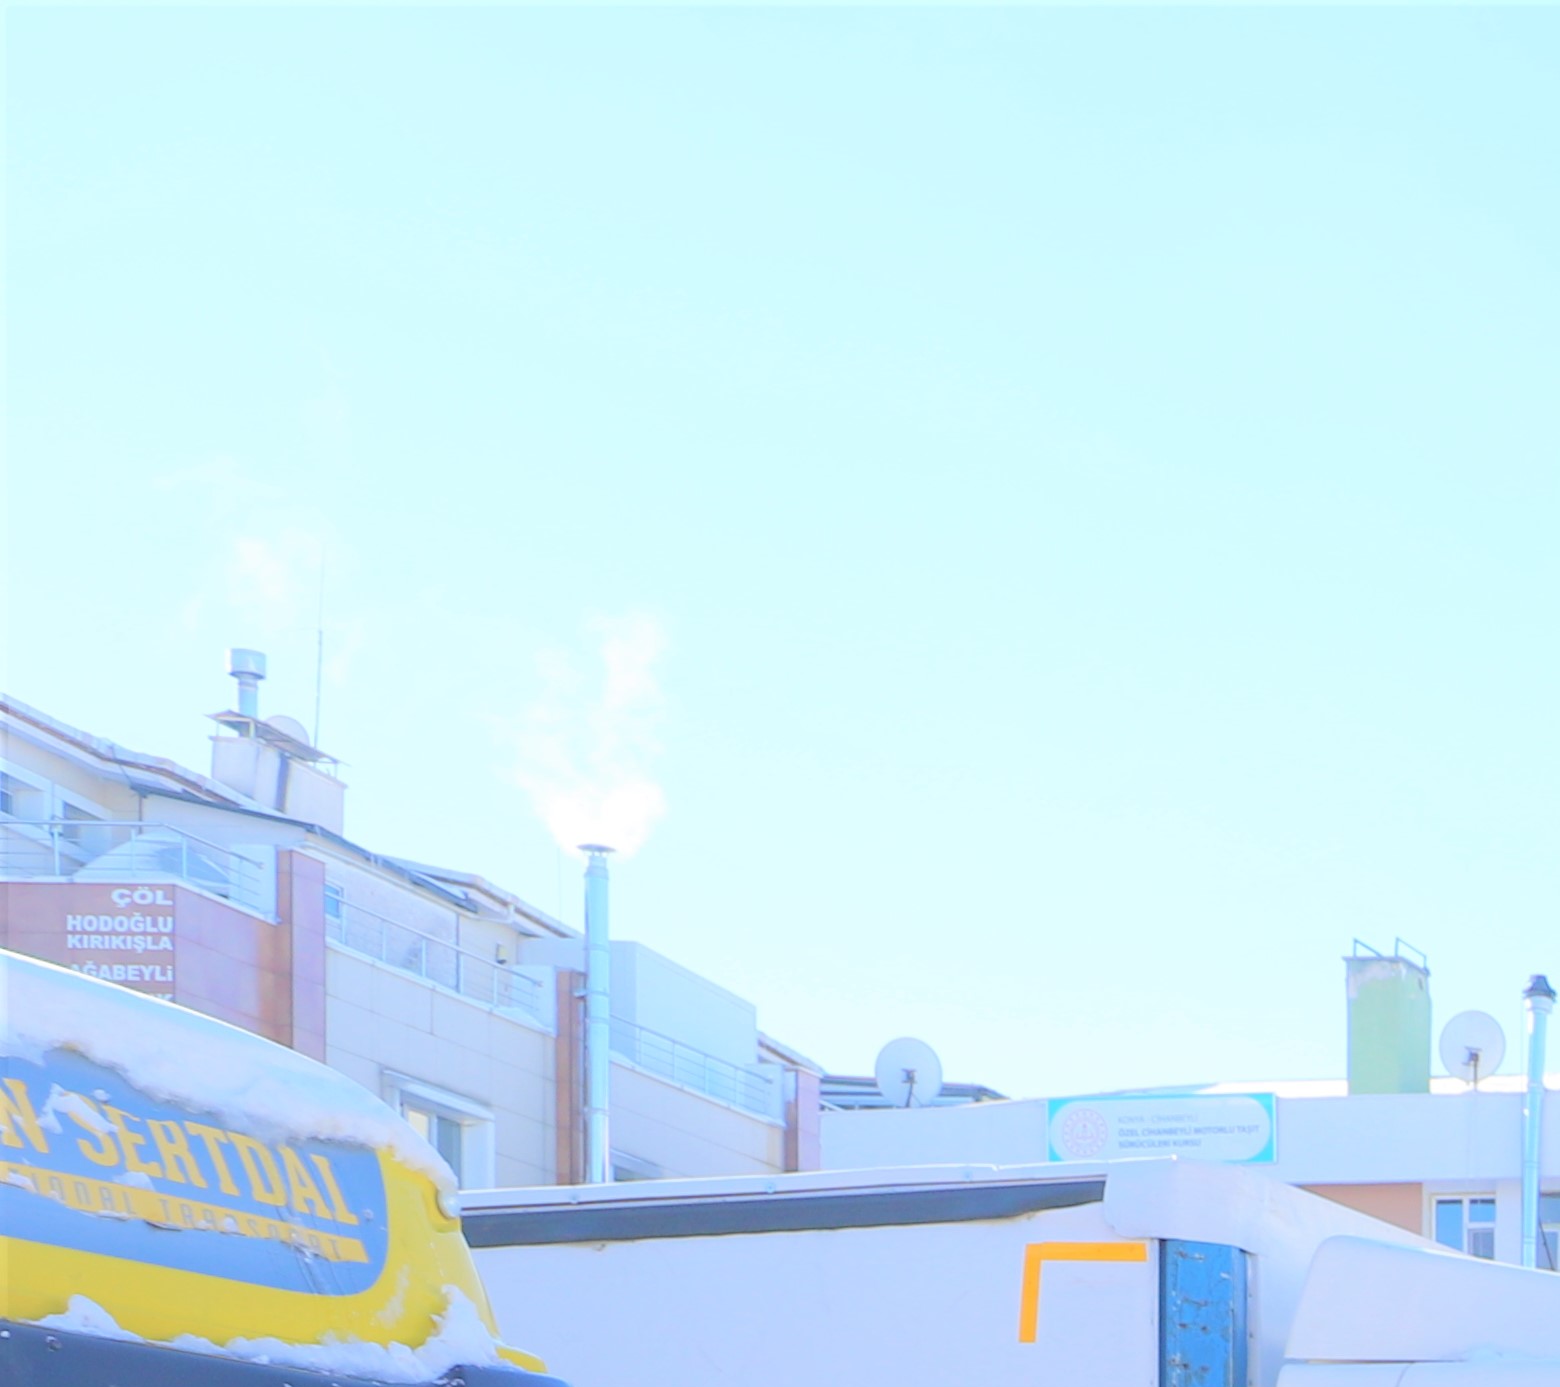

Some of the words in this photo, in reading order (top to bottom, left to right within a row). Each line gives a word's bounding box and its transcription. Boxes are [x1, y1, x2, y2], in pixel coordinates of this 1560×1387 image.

[111, 886, 174, 909] ÇÖL
[66, 911, 174, 933] HODOĞLU
[67, 934, 174, 954] KIRIKIŞLA
